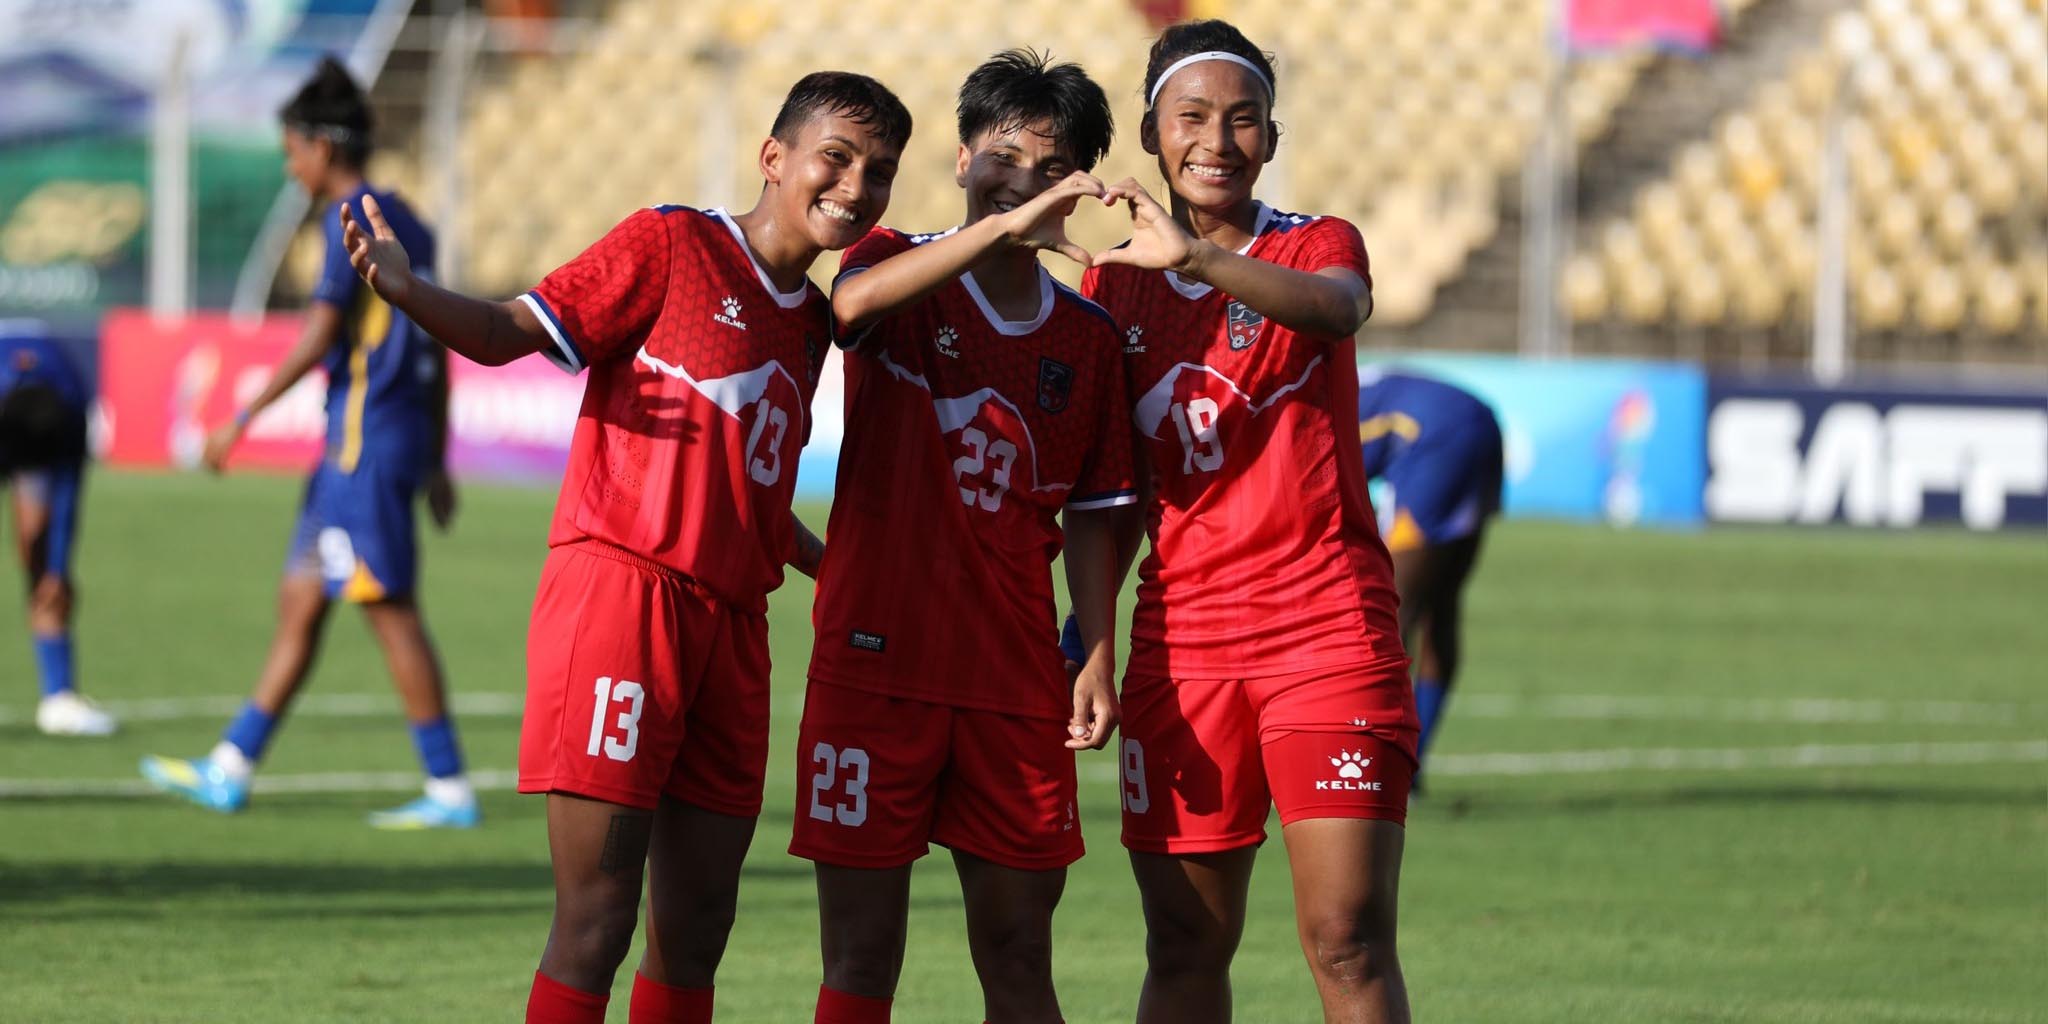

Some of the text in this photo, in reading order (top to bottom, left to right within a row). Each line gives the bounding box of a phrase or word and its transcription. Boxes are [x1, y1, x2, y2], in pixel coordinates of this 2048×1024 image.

[713, 313, 746, 330] KELME
[746, 398, 788, 487] 13
[953, 427, 1017, 512] 23
[1171, 397, 1224, 474] 19
[1707, 398, 2048, 530] SAFF
[587, 676, 645, 762] 13
[810, 742, 870, 827] 23
[1316, 781, 1382, 791] KELME
